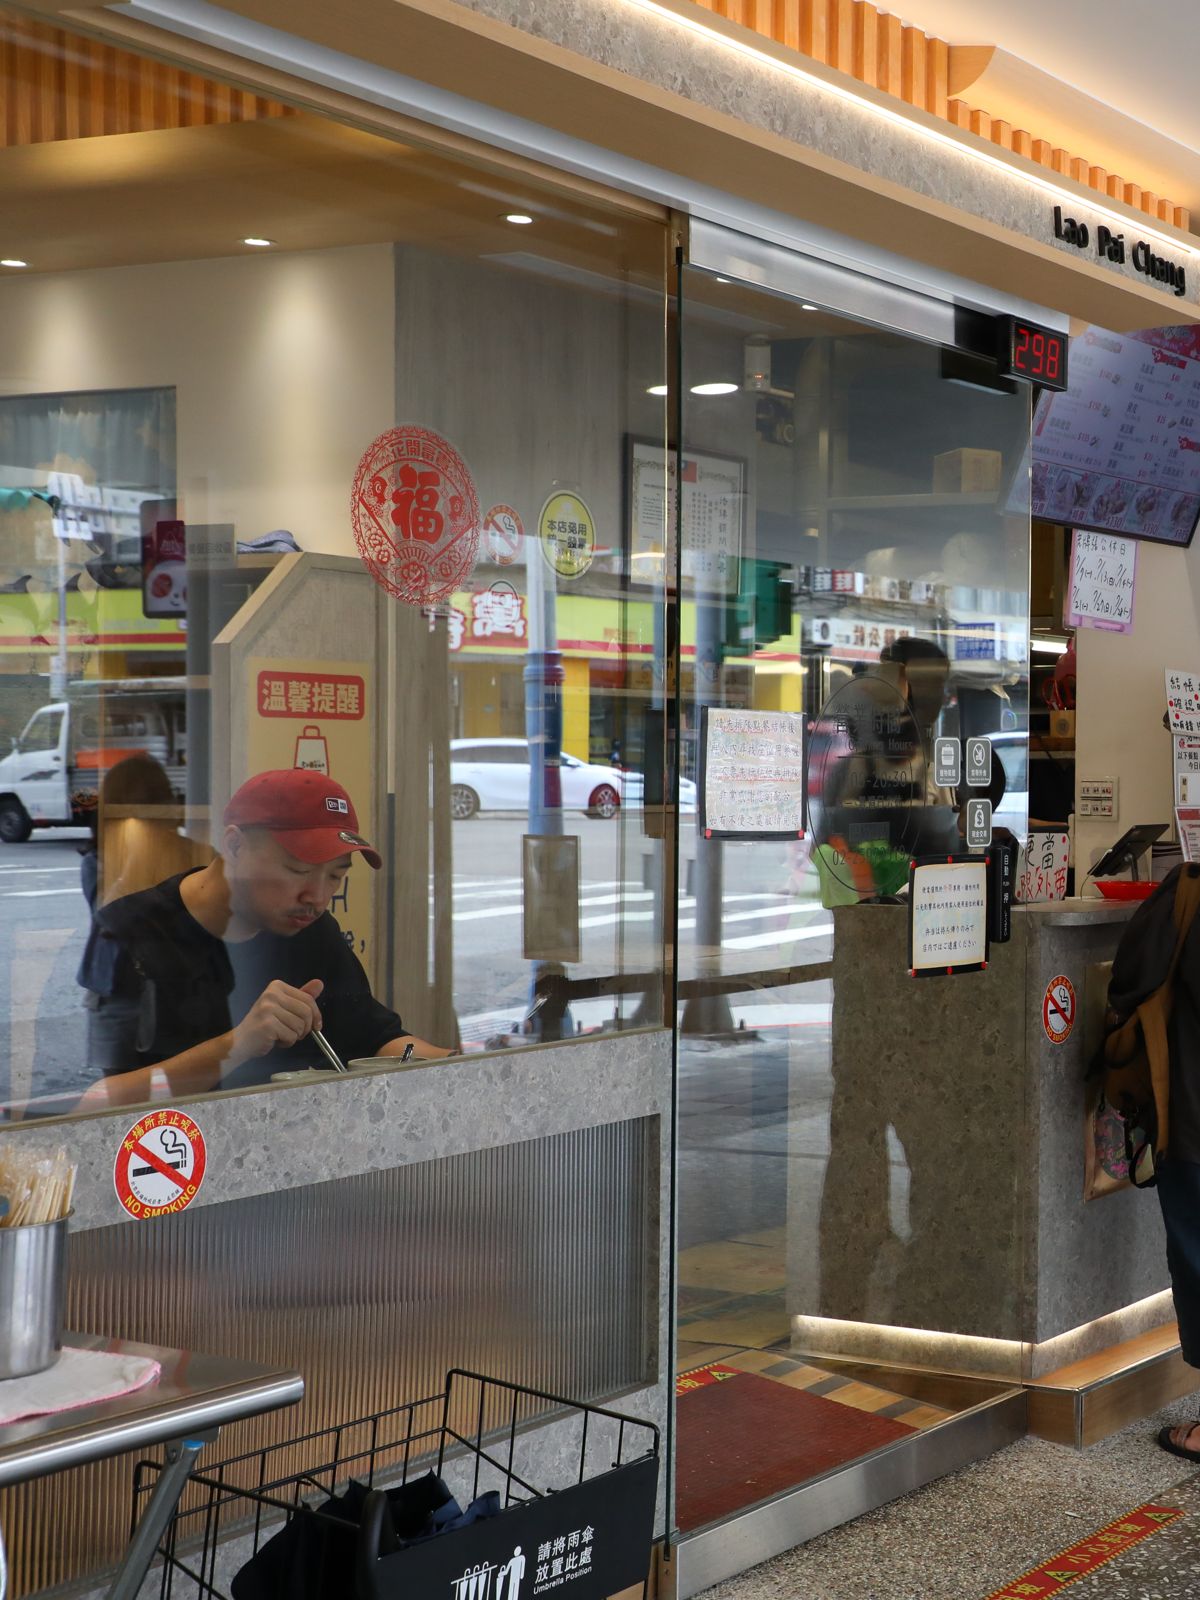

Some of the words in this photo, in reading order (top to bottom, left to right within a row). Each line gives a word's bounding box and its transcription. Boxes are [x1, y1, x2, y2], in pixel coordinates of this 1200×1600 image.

[1054, 206, 1089, 248] Lao
[1098, 225, 1125, 265] Pai
[1132, 240, 1186, 296] Chang
[1015, 329, 1060, 379] 298
[391, 463, 445, 545] 福
[262, 679, 360, 714] 溫馨提醒
[888, 738, 913, 751] Hours
[124, 1111, 200, 1152] 本場所禁止吸菸
[125, 1194, 140, 1214] NO
[143, 1184, 196, 1219] SMOKING
[537, 1525, 595, 1562] 請將雨傘
[1066, 1522, 1145, 1564] 小心斜坡
[533, 1576, 565, 1595] Umbrella
[565, 1566, 593, 1582] Position
[535, 1546, 593, 1584] 放置此處
